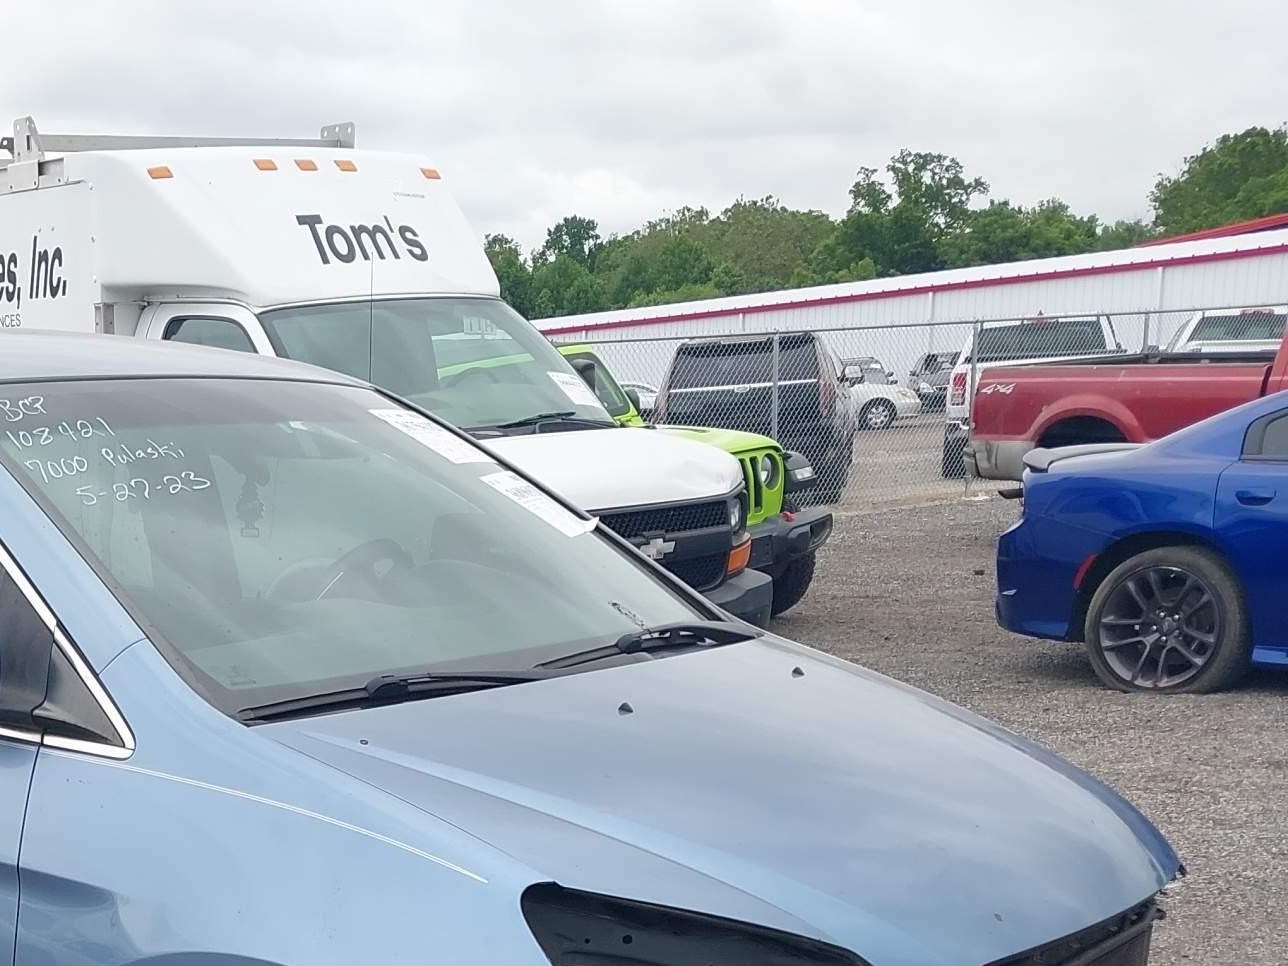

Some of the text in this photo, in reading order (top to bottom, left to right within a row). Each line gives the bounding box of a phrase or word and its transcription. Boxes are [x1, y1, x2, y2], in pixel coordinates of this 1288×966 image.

[295, 214, 429, 265] Tom's
[30, 235, 67, 300] Inc.
[24, 438, 185, 483] 7000 Pulaski
[76, 471, 211, 505] 5-27-23
